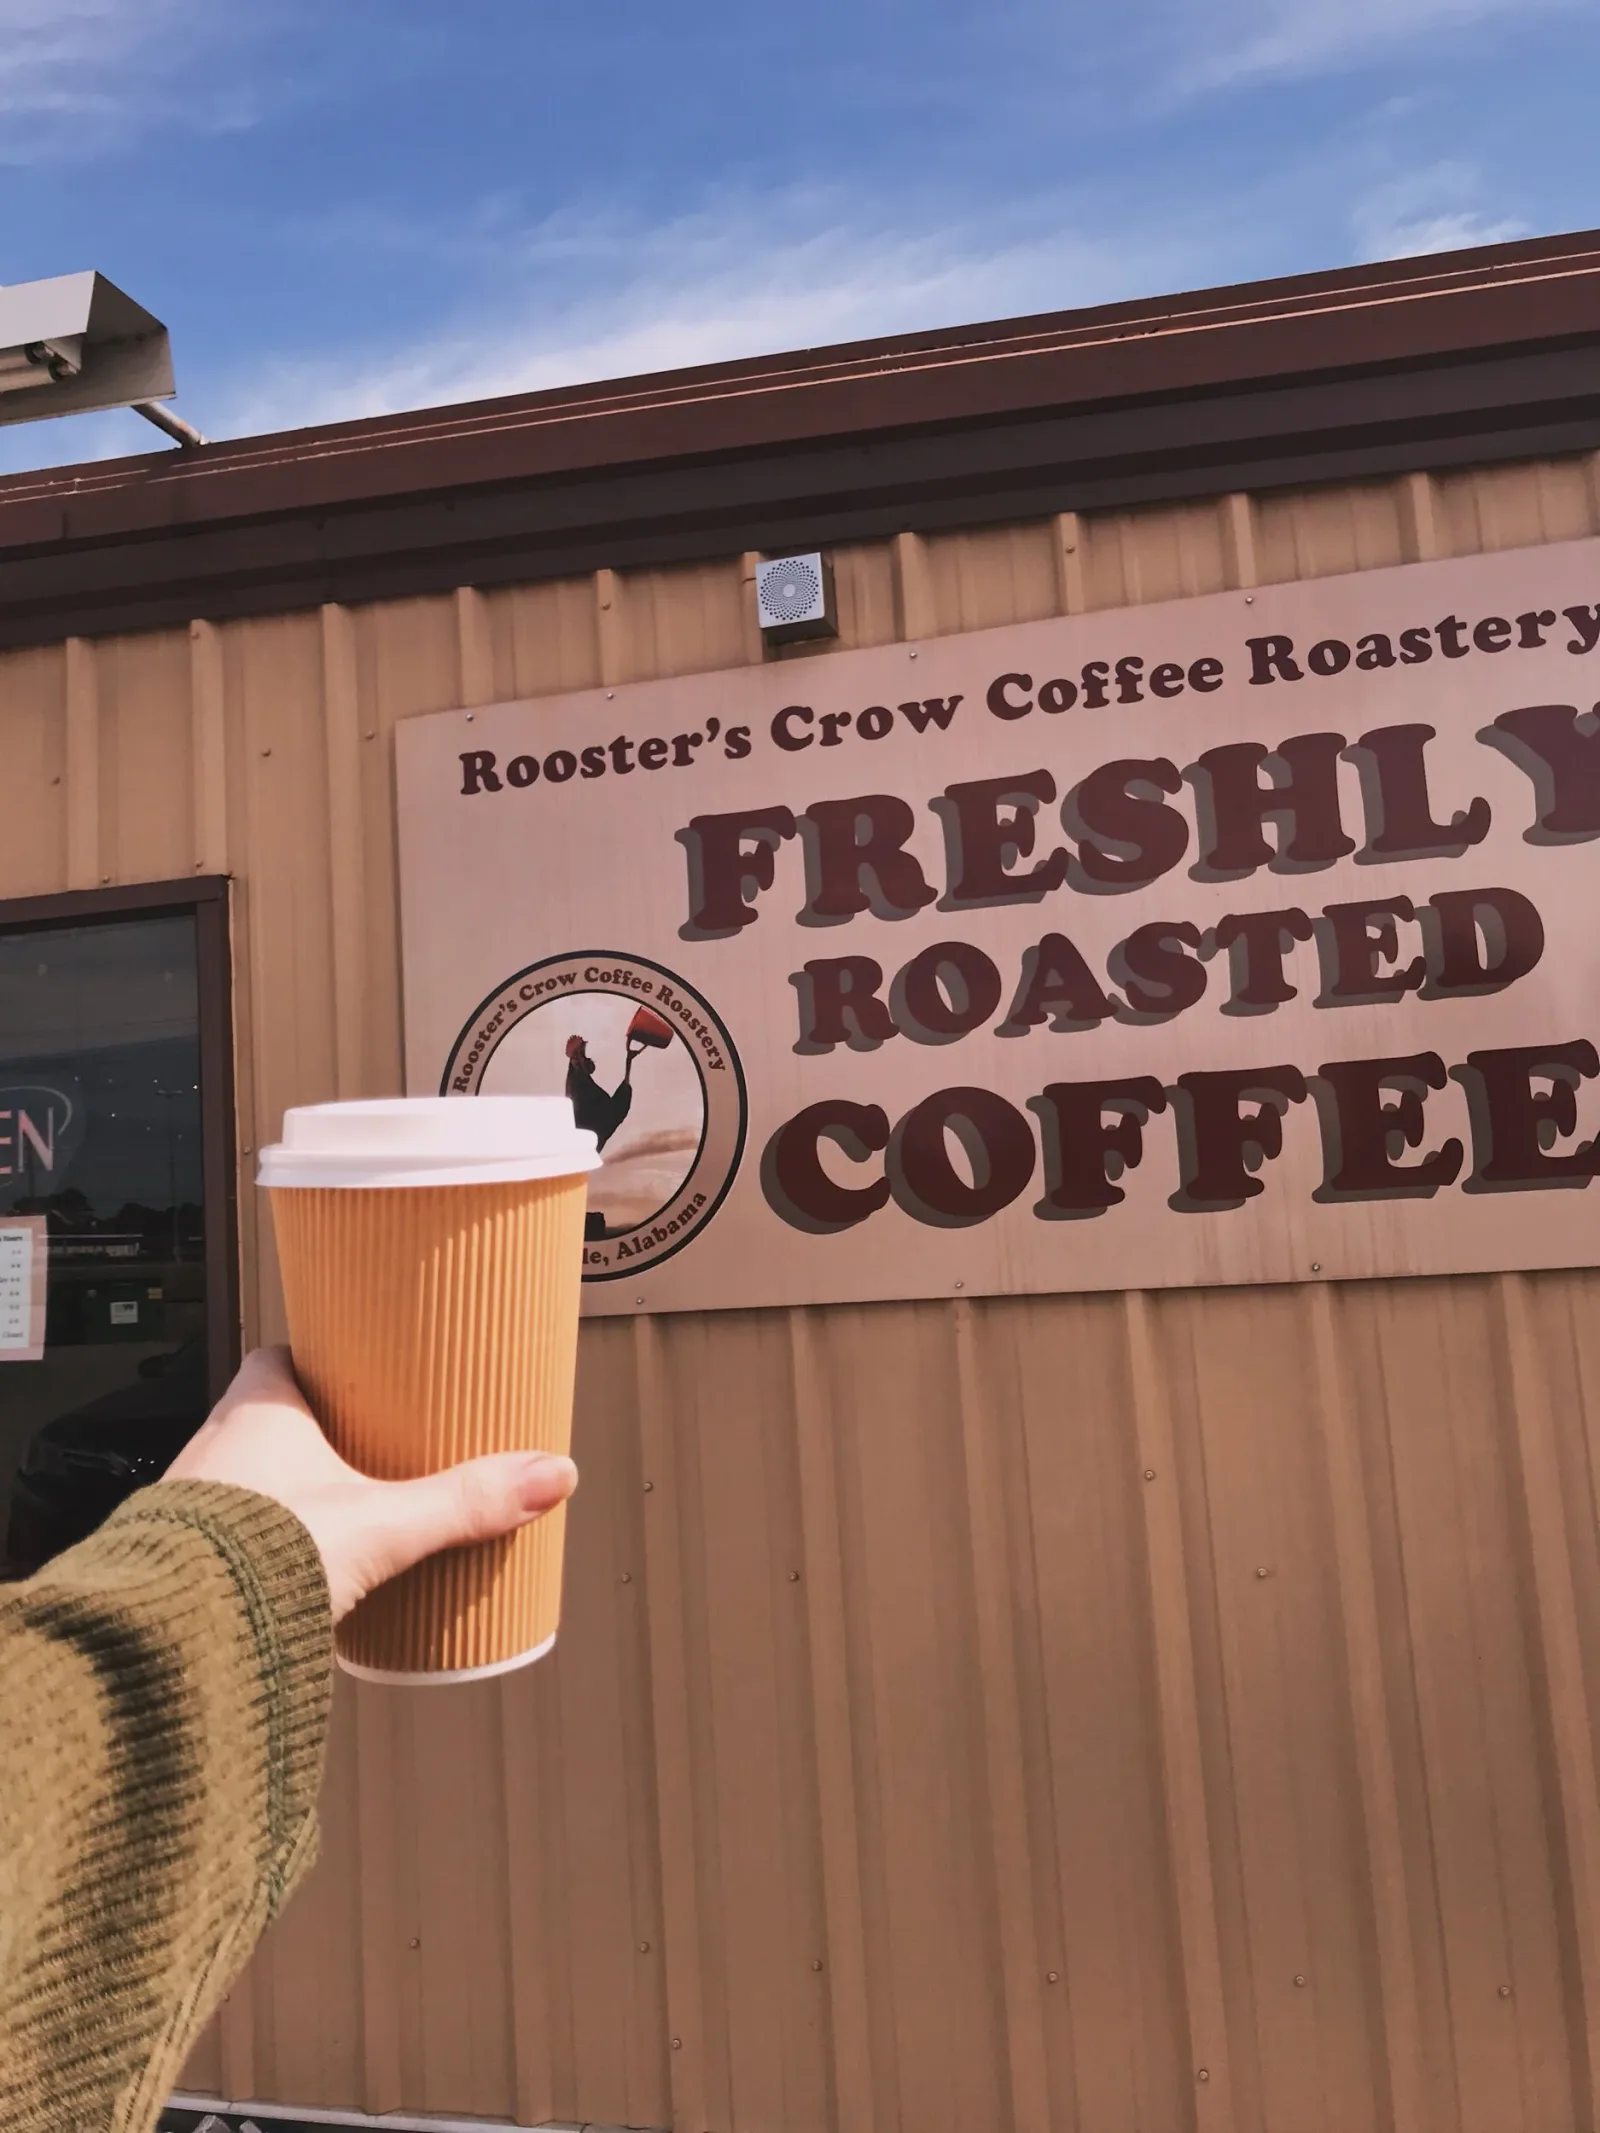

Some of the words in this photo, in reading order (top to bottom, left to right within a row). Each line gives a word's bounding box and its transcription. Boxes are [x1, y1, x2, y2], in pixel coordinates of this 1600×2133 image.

[459, 718, 752, 795] Rooster's
[771, 695, 963, 753] Crow
[987, 656, 1223, 721] Coffee
[1245, 604, 1600, 686] Roastery
[674, 700, 1600, 941] FRESHLY
[452, 1000, 519, 1094] Rooster's
[518, 971, 577, 1002] Crow
[584, 966, 653, 994] Coffee
[655, 984, 726, 1073] Roastery
[788, 887, 1545, 1056] ROASTED
[616, 1192, 707, 1260] Alabama
[760, 1038, 1600, 1235] COFFEE
